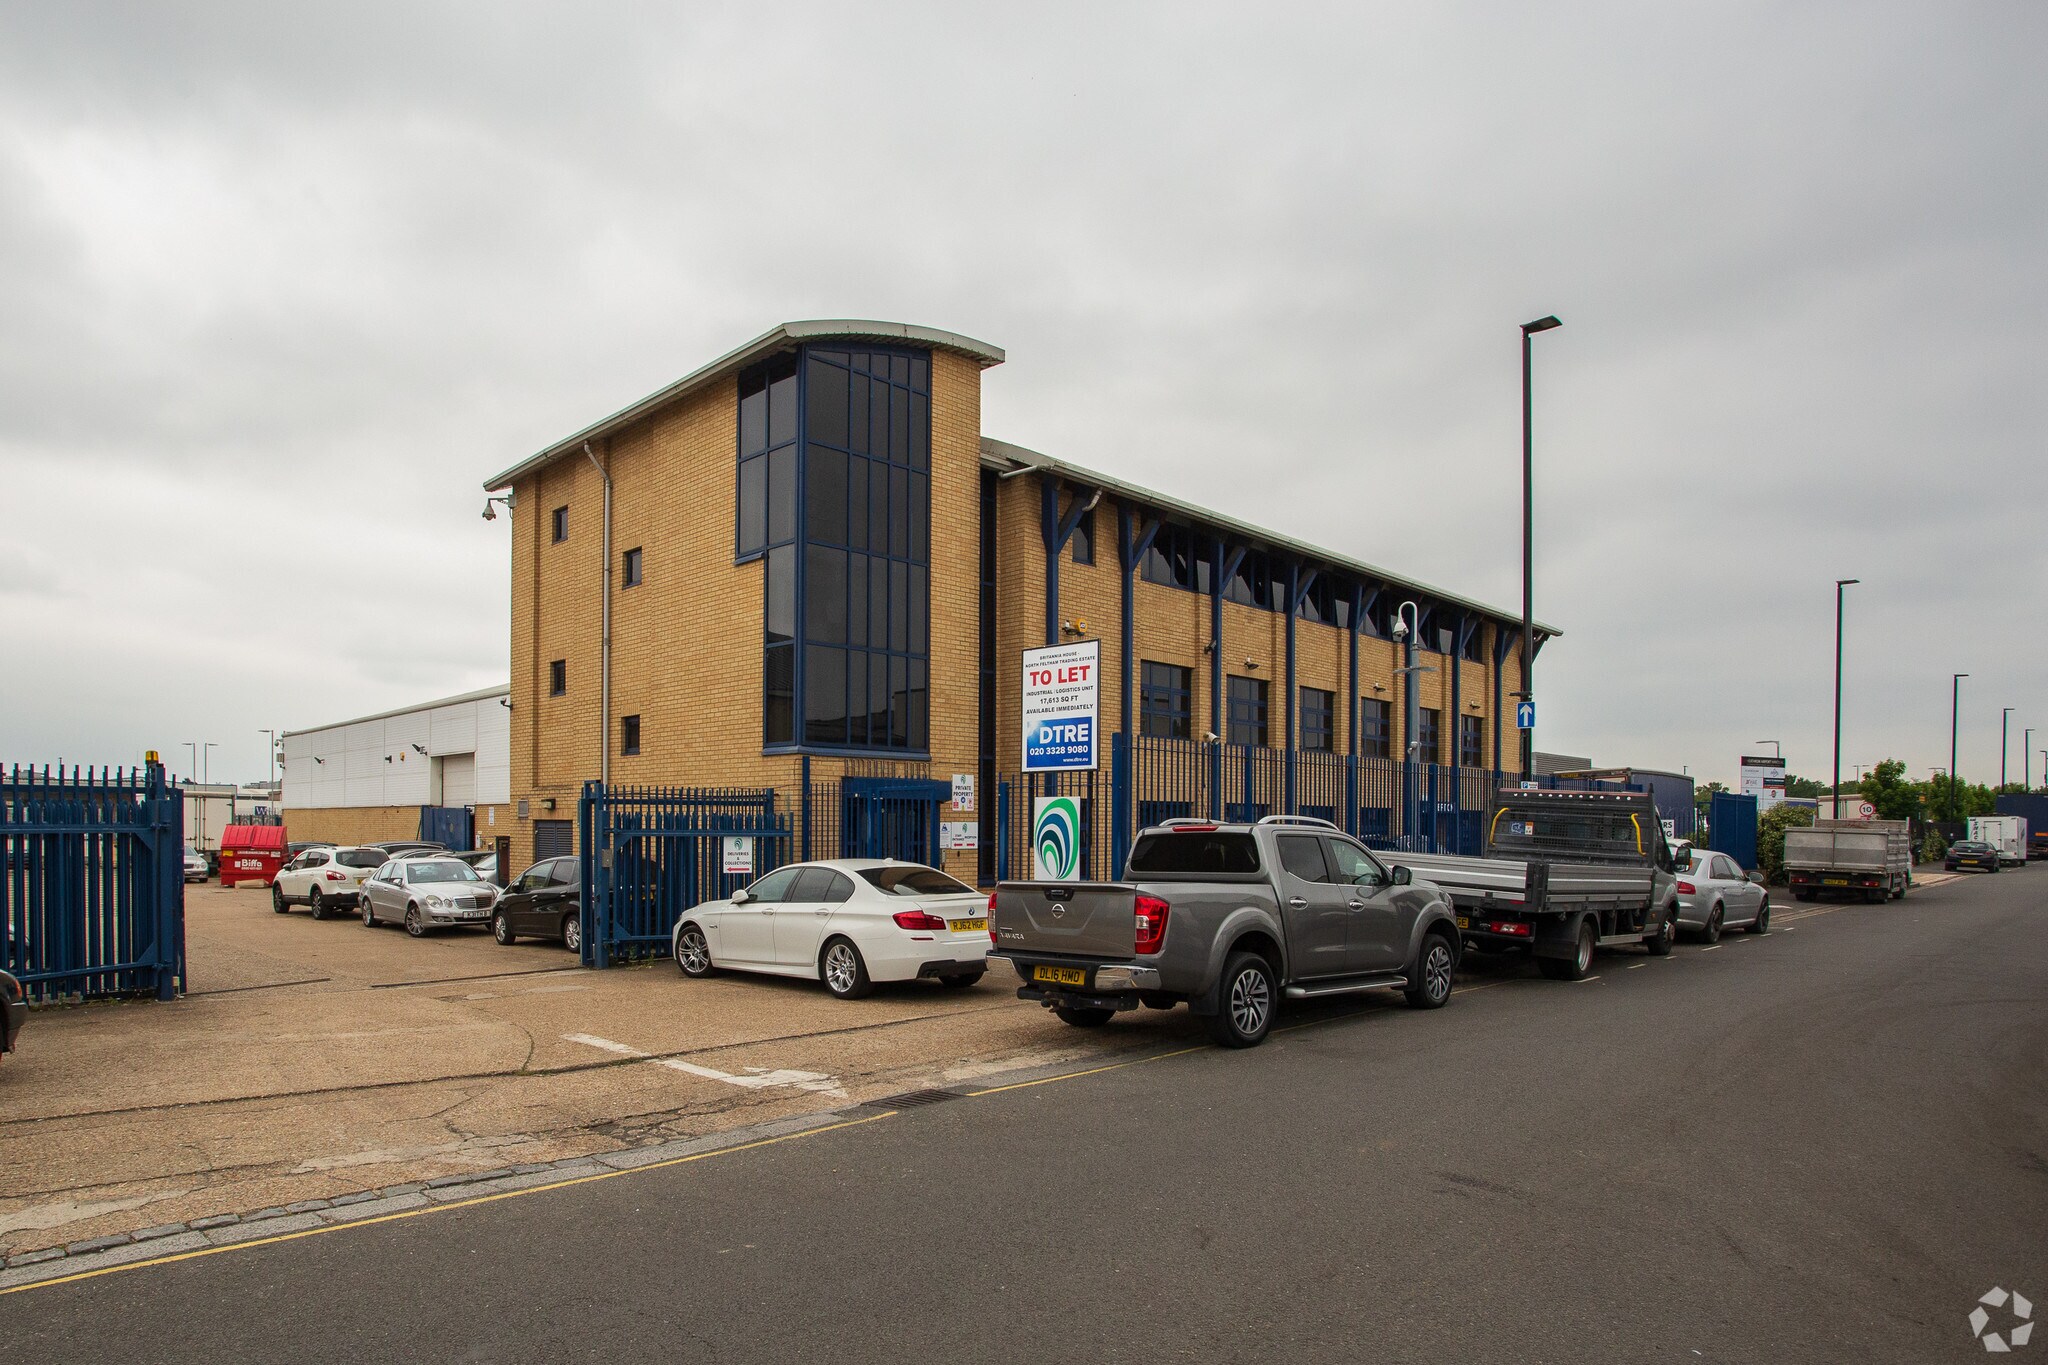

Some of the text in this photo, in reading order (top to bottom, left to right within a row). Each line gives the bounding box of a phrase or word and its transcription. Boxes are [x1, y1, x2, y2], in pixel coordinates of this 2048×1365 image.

[1029, 665, 1091, 687] TO LET
[1055, 686, 1081, 694] LOGISTICS
[1040, 697, 1060, 705] 17,613
[1026, 703, 1094, 715] AVAILABLE IMMEDIATELY
[1039, 723, 1089, 744] DTRE
[1029, 745, 1089, 756] 020 3328 9080
[241, 858, 263, 867] Biffa
[953, 919, 985, 930] RJ62 HGF
[1000, 932, 1025, 940] NAVARA
[1040, 967, 1080, 982] DL16 HMO
